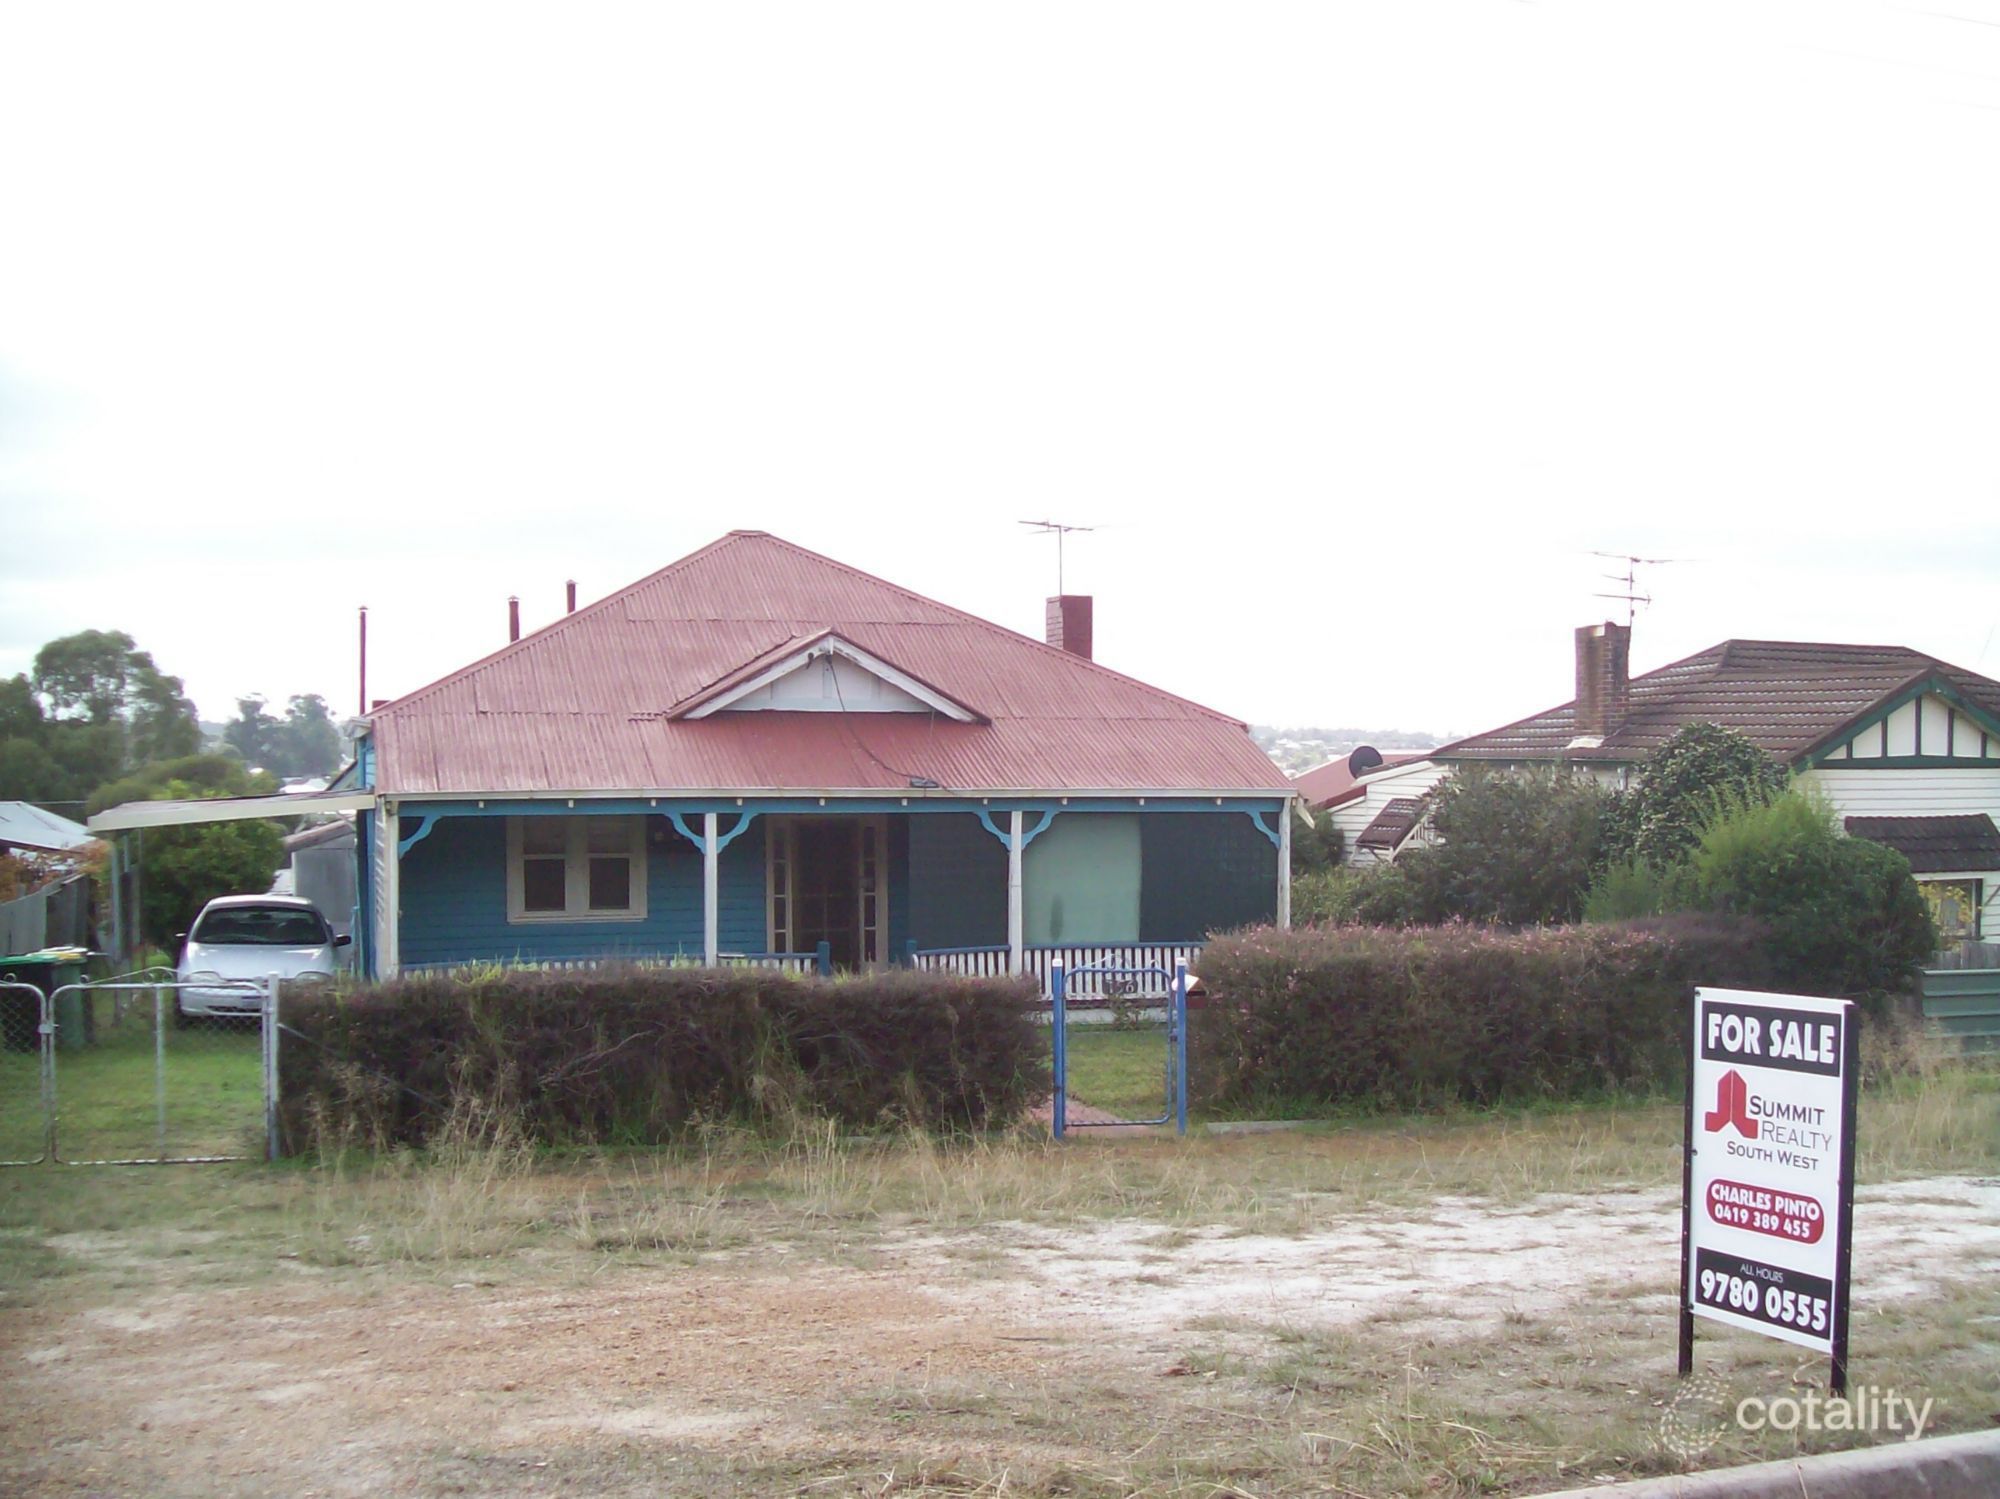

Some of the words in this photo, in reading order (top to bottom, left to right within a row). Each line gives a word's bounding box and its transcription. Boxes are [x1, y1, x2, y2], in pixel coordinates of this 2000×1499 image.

[1708, 1013, 1761, 1055] FOR
[1769, 1019, 1835, 1064] SALE
[1750, 1095, 1825, 1125] SUMMIT
[1762, 1120, 1832, 1151] REALTY
[1727, 1141, 1773, 1163] SOUTH
[1777, 1150, 1819, 1171] WEST
[1711, 1183, 1771, 1211] CHARLES
[1775, 1196, 1820, 1221] PINTO
[1714, 1203, 1749, 1224] 0419
[1753, 1213, 1779, 1231] 389
[1783, 1220, 1810, 1238] 455
[1740, 1263, 1754, 1276] ALL
[1756, 1267, 1783, 1284] HOURS
[1700, 1269, 1759, 1312] 9780
[1765, 1286, 1827, 1331] 0555
